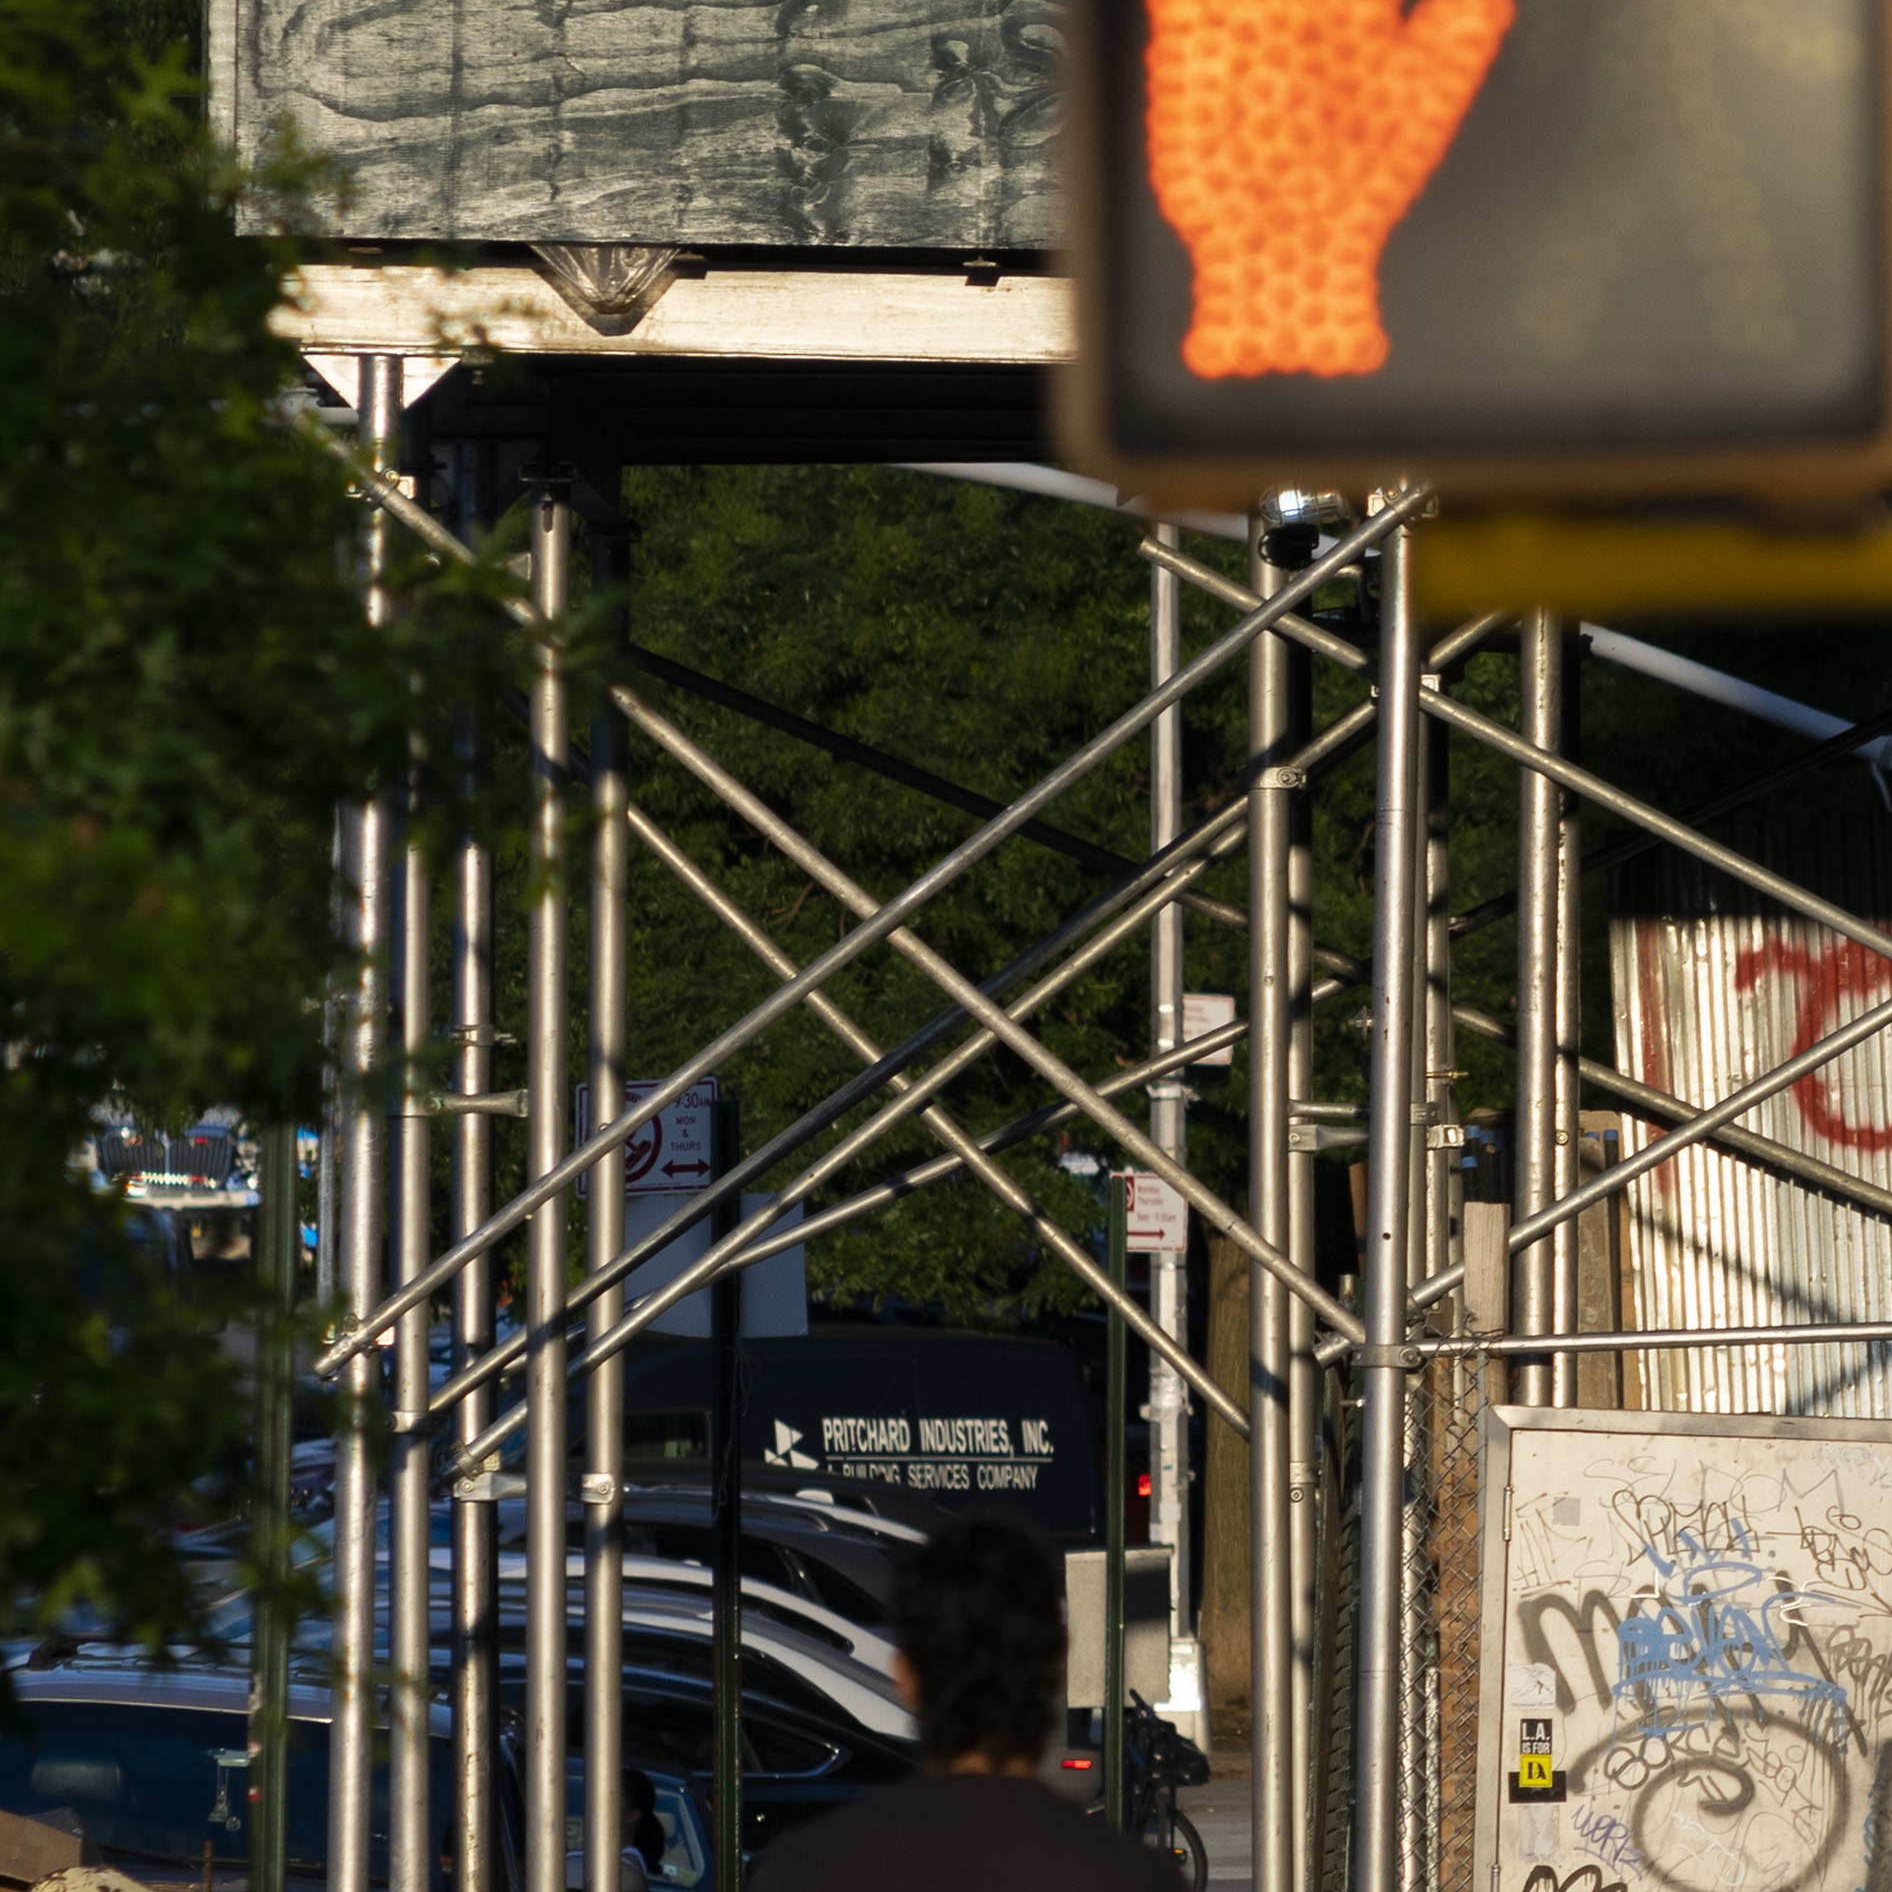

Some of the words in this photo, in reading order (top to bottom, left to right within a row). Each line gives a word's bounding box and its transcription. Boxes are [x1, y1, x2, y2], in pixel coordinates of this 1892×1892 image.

[675, 1116, 697, 1125] MON
[670, 1141, 702, 1151] THURS
[822, 1418, 910, 1452] PRITCHARD
[919, 1418, 1014, 1458] INDUSTRIES,
[1021, 1419, 1054, 1454] INC.
[908, 1464, 970, 1489] SERVICES
[976, 1465, 1038, 1490] COMPANY
[1522, 1722, 1550, 1740] L.A.
[1522, 1742, 1531, 1754] IS
[1532, 1742, 1550, 1754] FOR
